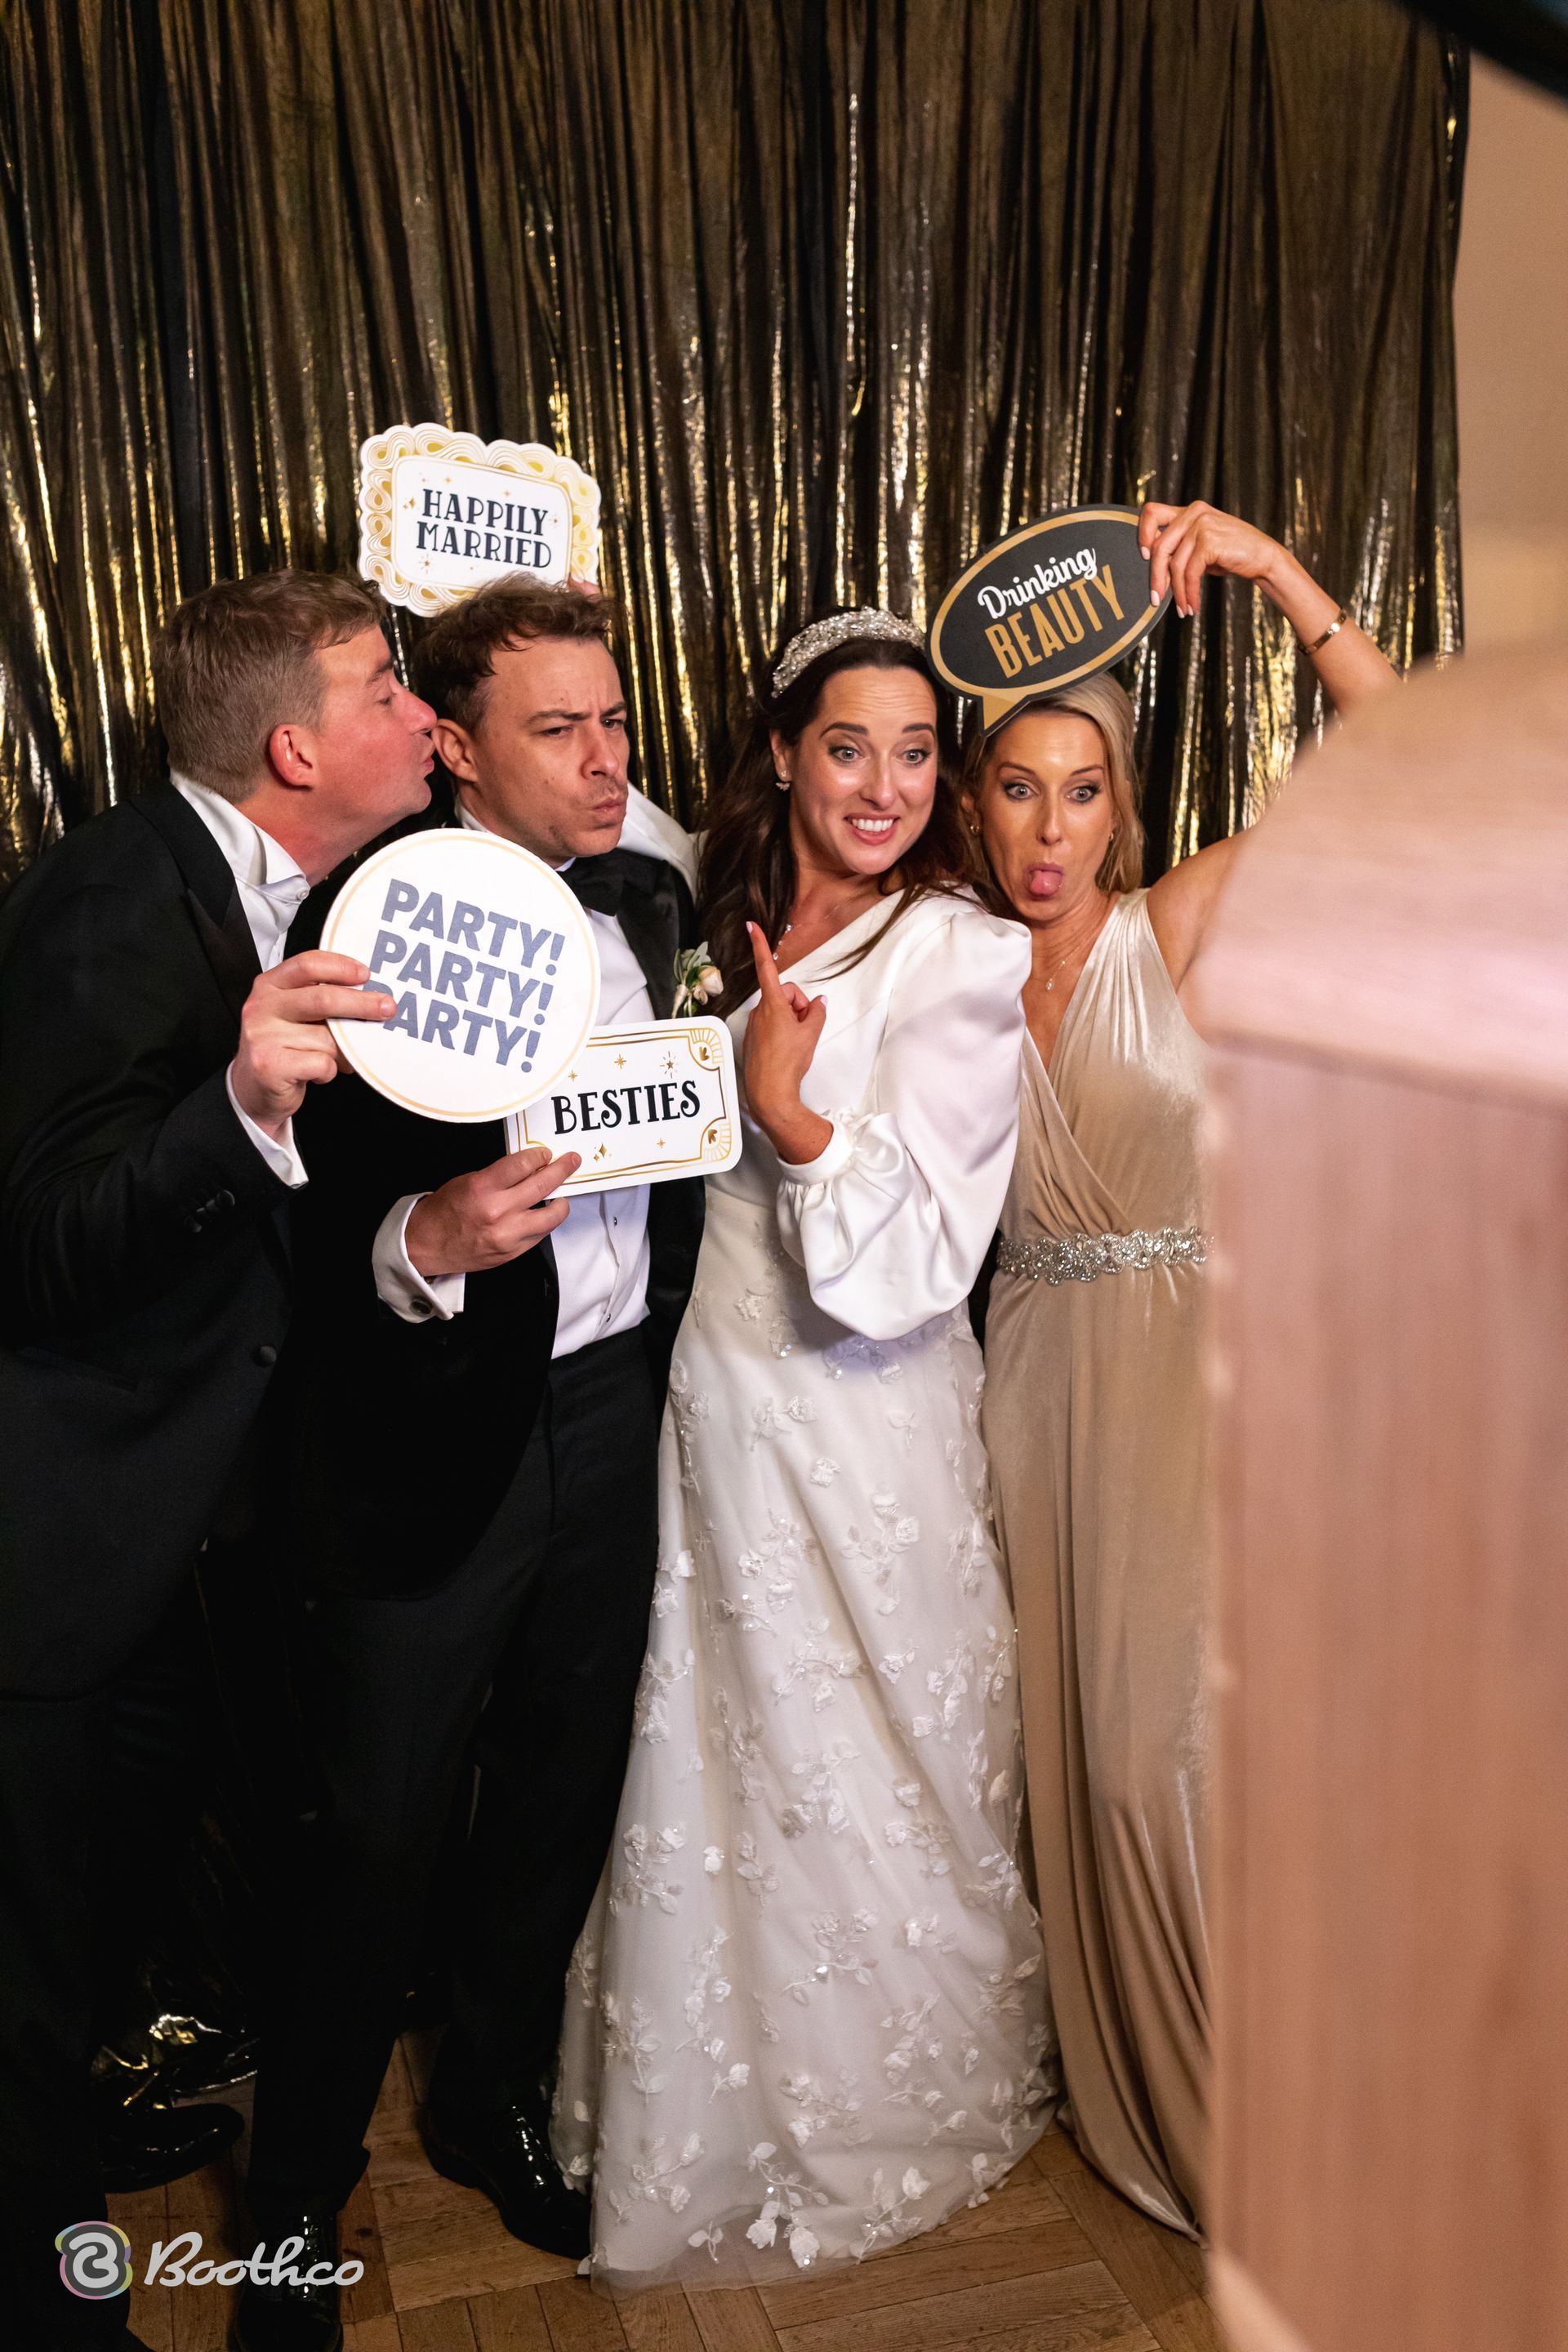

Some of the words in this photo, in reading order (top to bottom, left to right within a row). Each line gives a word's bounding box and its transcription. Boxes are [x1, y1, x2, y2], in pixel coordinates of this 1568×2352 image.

[416, 521, 551, 568] MARRIED
[422, 488, 548, 536] HAPPILY
[978, 548, 1098, 619] Drinking
[984, 564, 1125, 679] BEAUTY
[381, 878, 565, 976] PARTY!
[369, 929, 554, 1025] PARTY!
[551, 1080, 700, 1134] BESTIES
